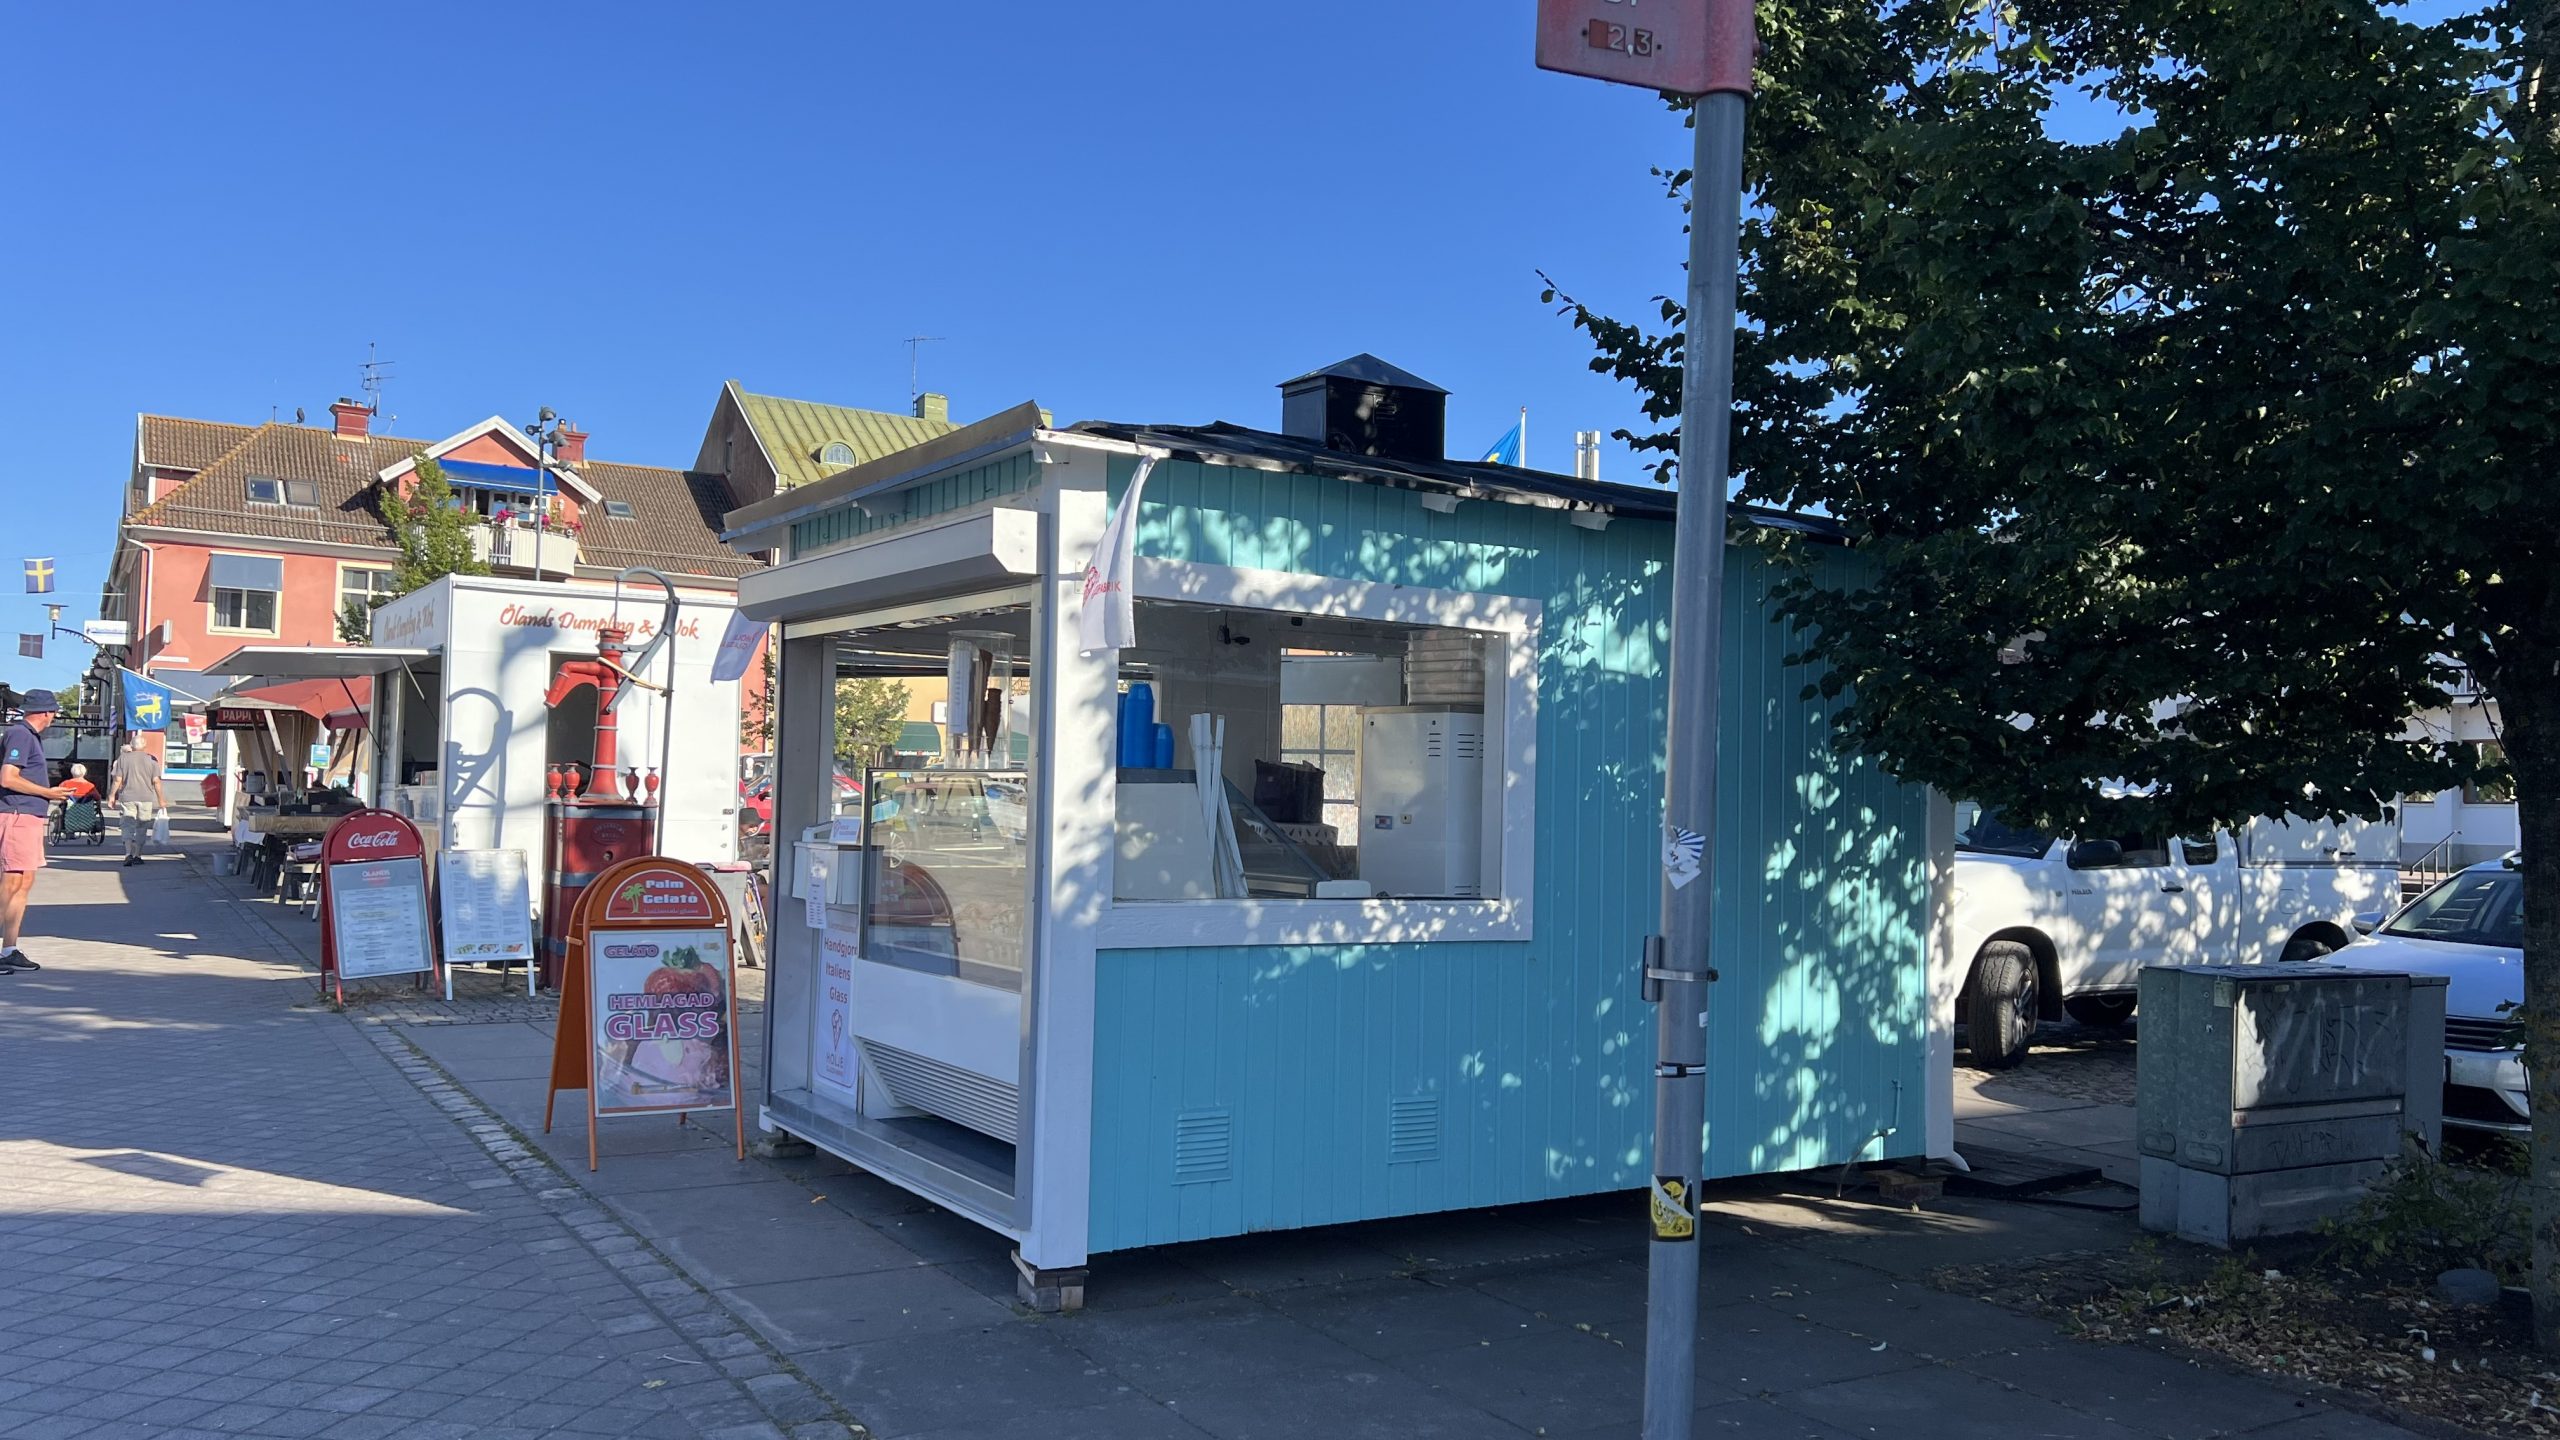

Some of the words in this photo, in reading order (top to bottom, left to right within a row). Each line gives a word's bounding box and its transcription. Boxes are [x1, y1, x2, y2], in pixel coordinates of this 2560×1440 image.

[500, 604, 554, 628] Ölands
[559, 612, 635, 641] Dumplng
[638, 619, 655, 637] &
[347, 830, 400, 849] Coca-Cola
[645, 879, 684, 889] Palm
[605, 945, 658, 958] GELATO
[826, 961, 851, 981] Italiens
[608, 992, 715, 1010] HEMLAGAD
[829, 986, 848, 1004] Glass
[606, 1010, 720, 1041] GLASS
